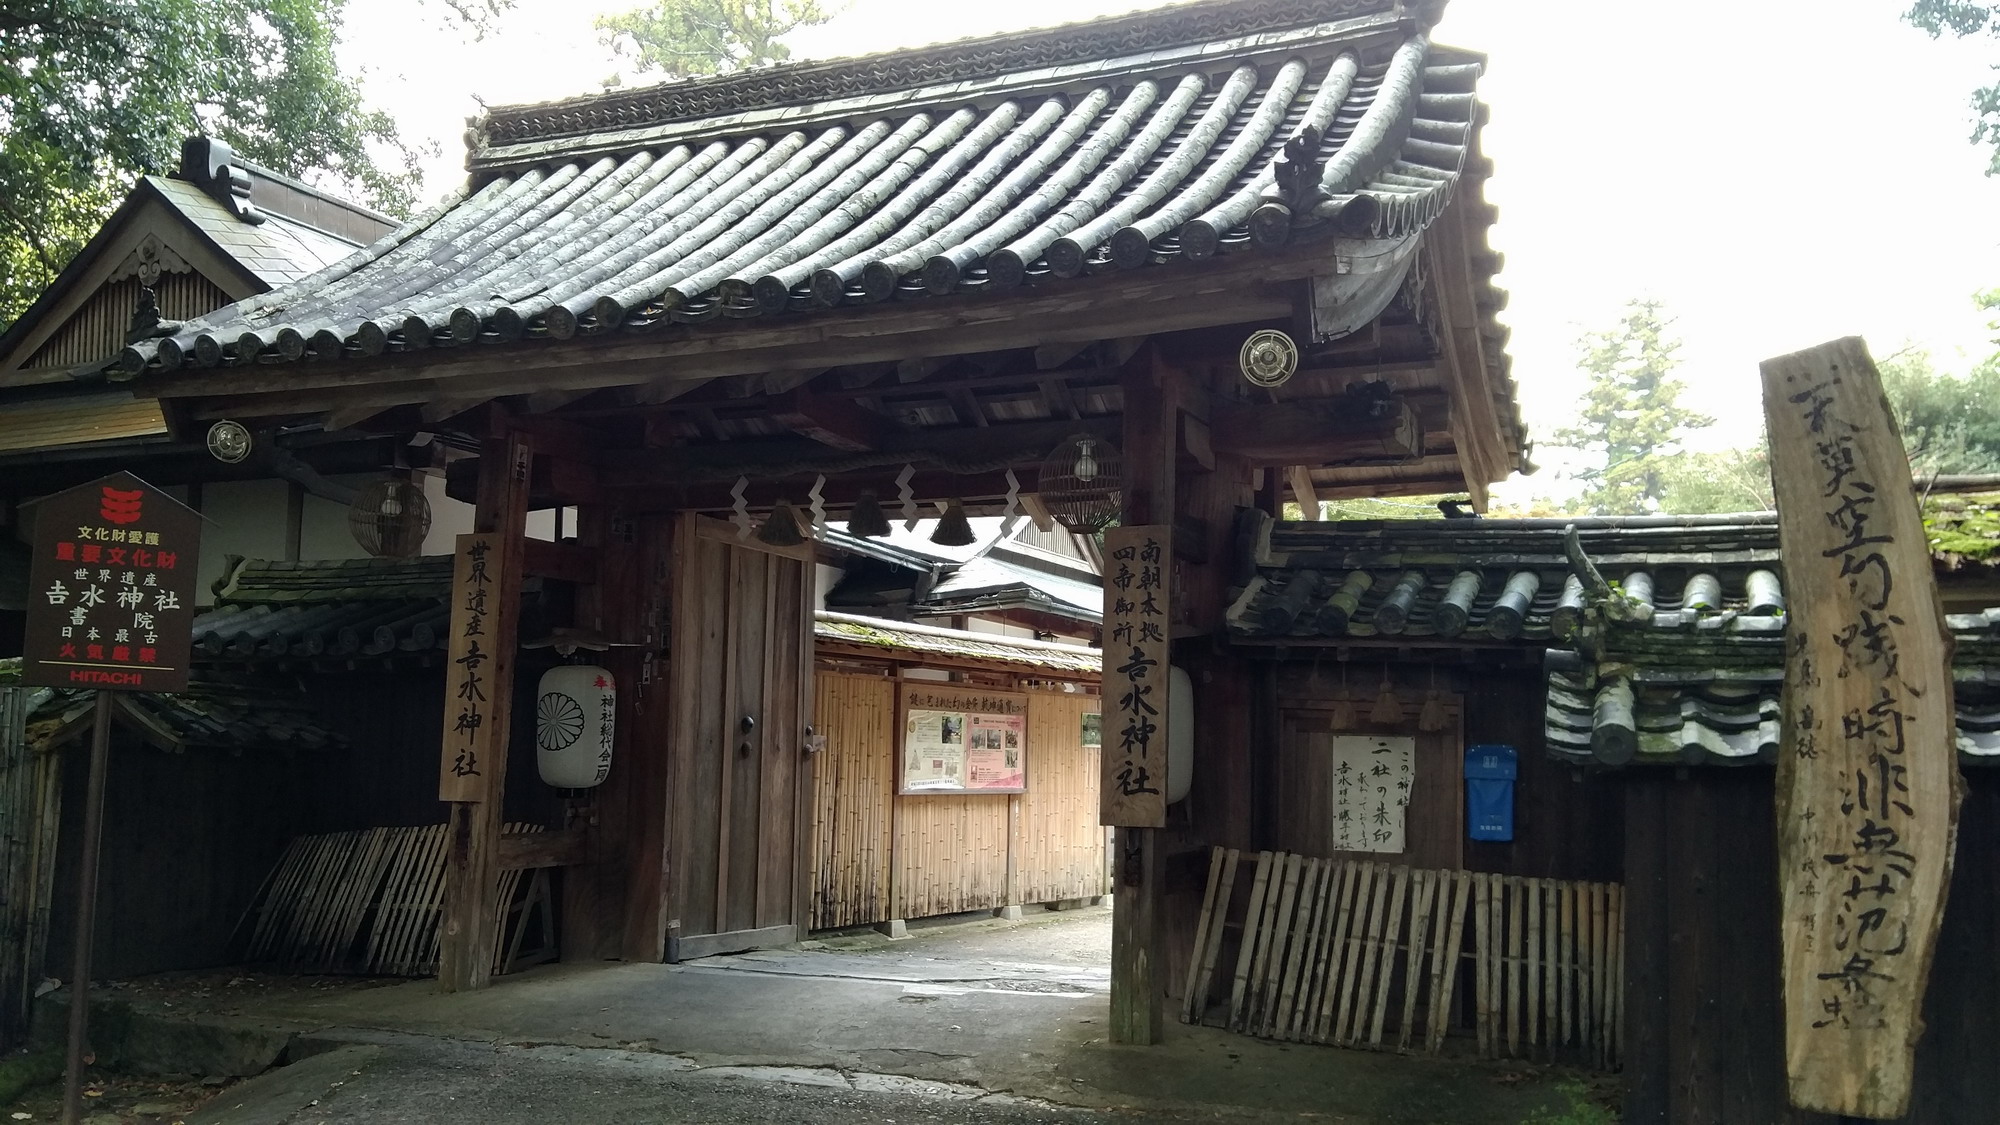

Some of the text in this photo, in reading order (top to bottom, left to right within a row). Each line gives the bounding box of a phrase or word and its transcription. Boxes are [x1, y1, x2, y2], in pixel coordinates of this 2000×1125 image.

[78, 526, 160, 546] 文化財愛護
[55, 542, 177, 570] 重要文化財
[74, 568, 158, 588] 世界遺産
[1112, 546, 1137, 647] 四帝御所
[61, 626, 159, 645] 日本最古
[70, 670, 142, 685] HITACHI
[1370, 741, 1393, 845] 二社の朱印
